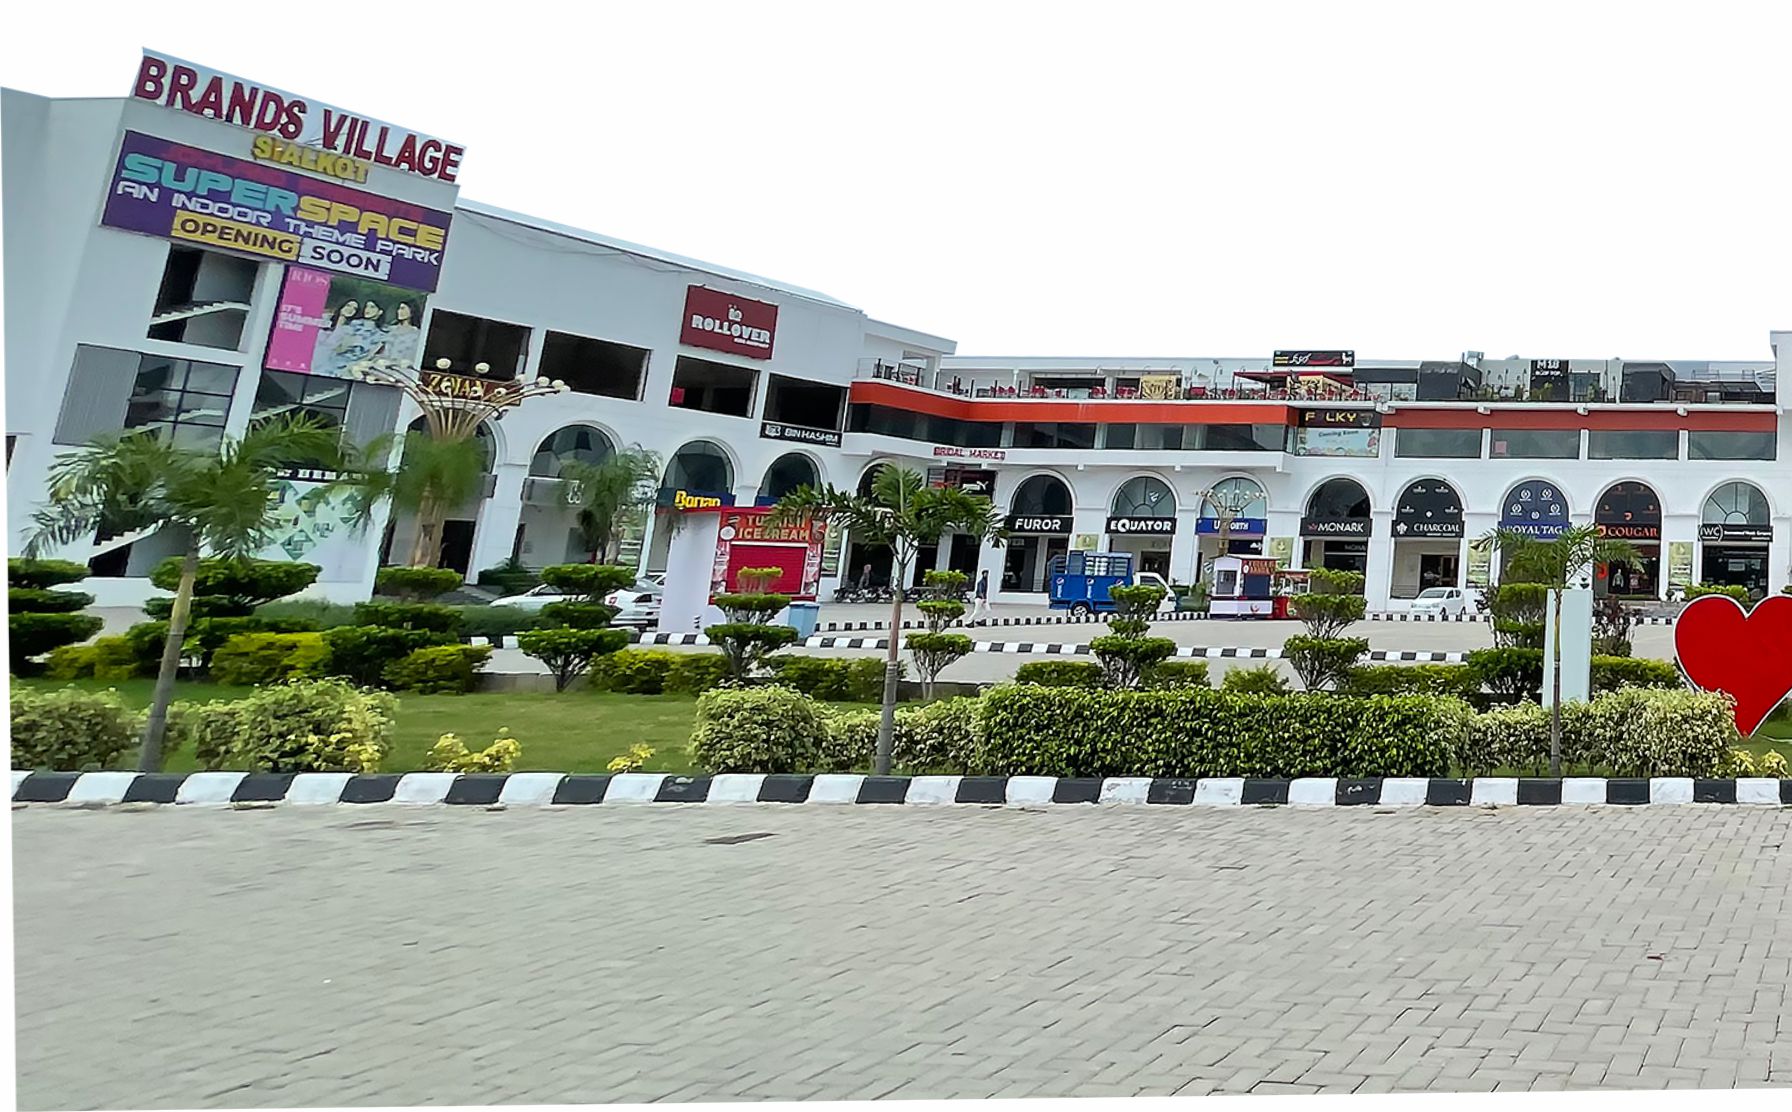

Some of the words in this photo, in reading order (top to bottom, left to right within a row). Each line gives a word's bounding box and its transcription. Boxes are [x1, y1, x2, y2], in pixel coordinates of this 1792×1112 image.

[134, 54, 308, 141] BRANDS
[321, 107, 467, 183] VILLAGE
[252, 133, 369, 184] SIALKOT
[116, 180, 159, 202] AN
[171, 192, 272, 227] INDOOR
[284, 217, 366, 249] THEME
[376, 239, 440, 267] PARK
[180, 218, 294, 255] OPENING
[310, 245, 381, 273] SOON
[691, 314, 770, 343] ROLLOVER
[1014, 518, 1062, 531] FUROR
[1110, 518, 1172, 533] EQUATOR
[1317, 522, 1365, 533] MONARK
[1413, 523, 1460, 533] CHARCOAL
[1607, 526, 1658, 537] COUGAR
